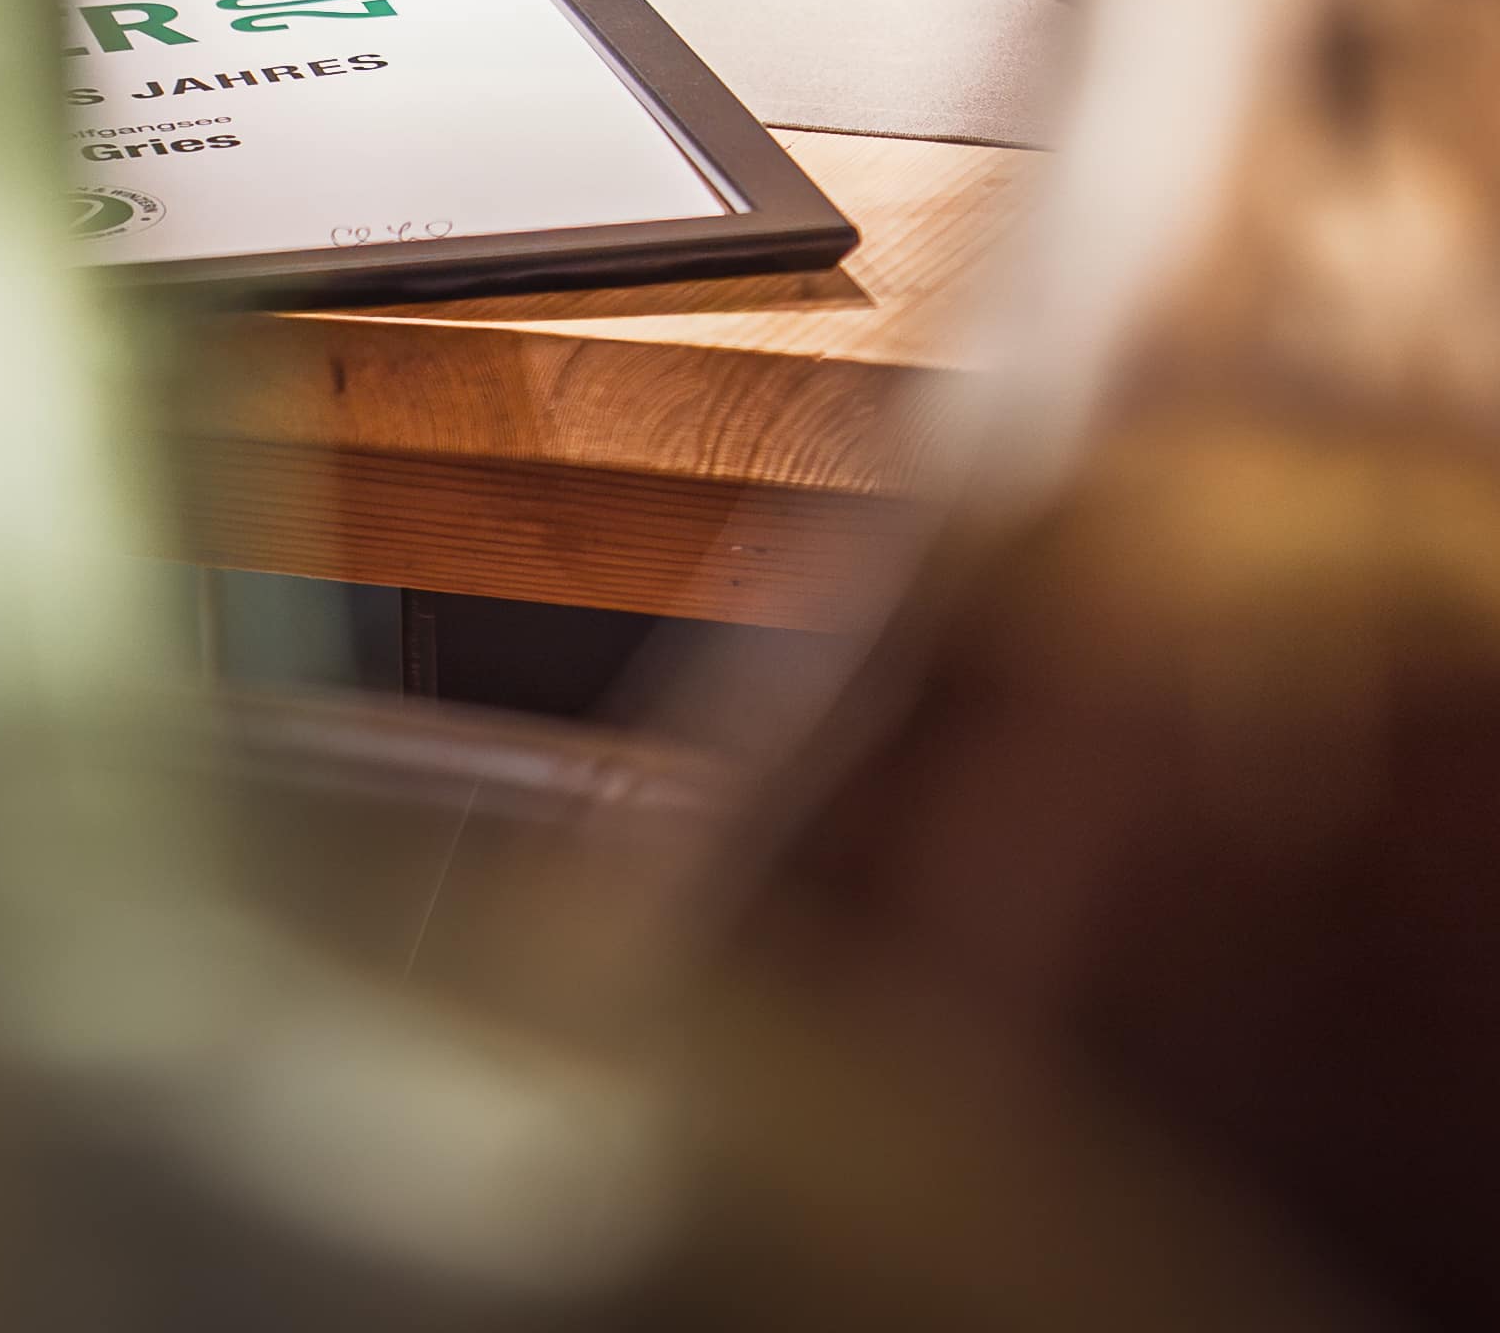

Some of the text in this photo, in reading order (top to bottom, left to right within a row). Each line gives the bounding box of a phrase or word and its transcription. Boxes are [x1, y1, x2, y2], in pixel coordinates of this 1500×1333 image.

[61, 2, 199, 57] R
[131, 53, 389, 100] JAHRES
[81, 134, 241, 162] Gries
